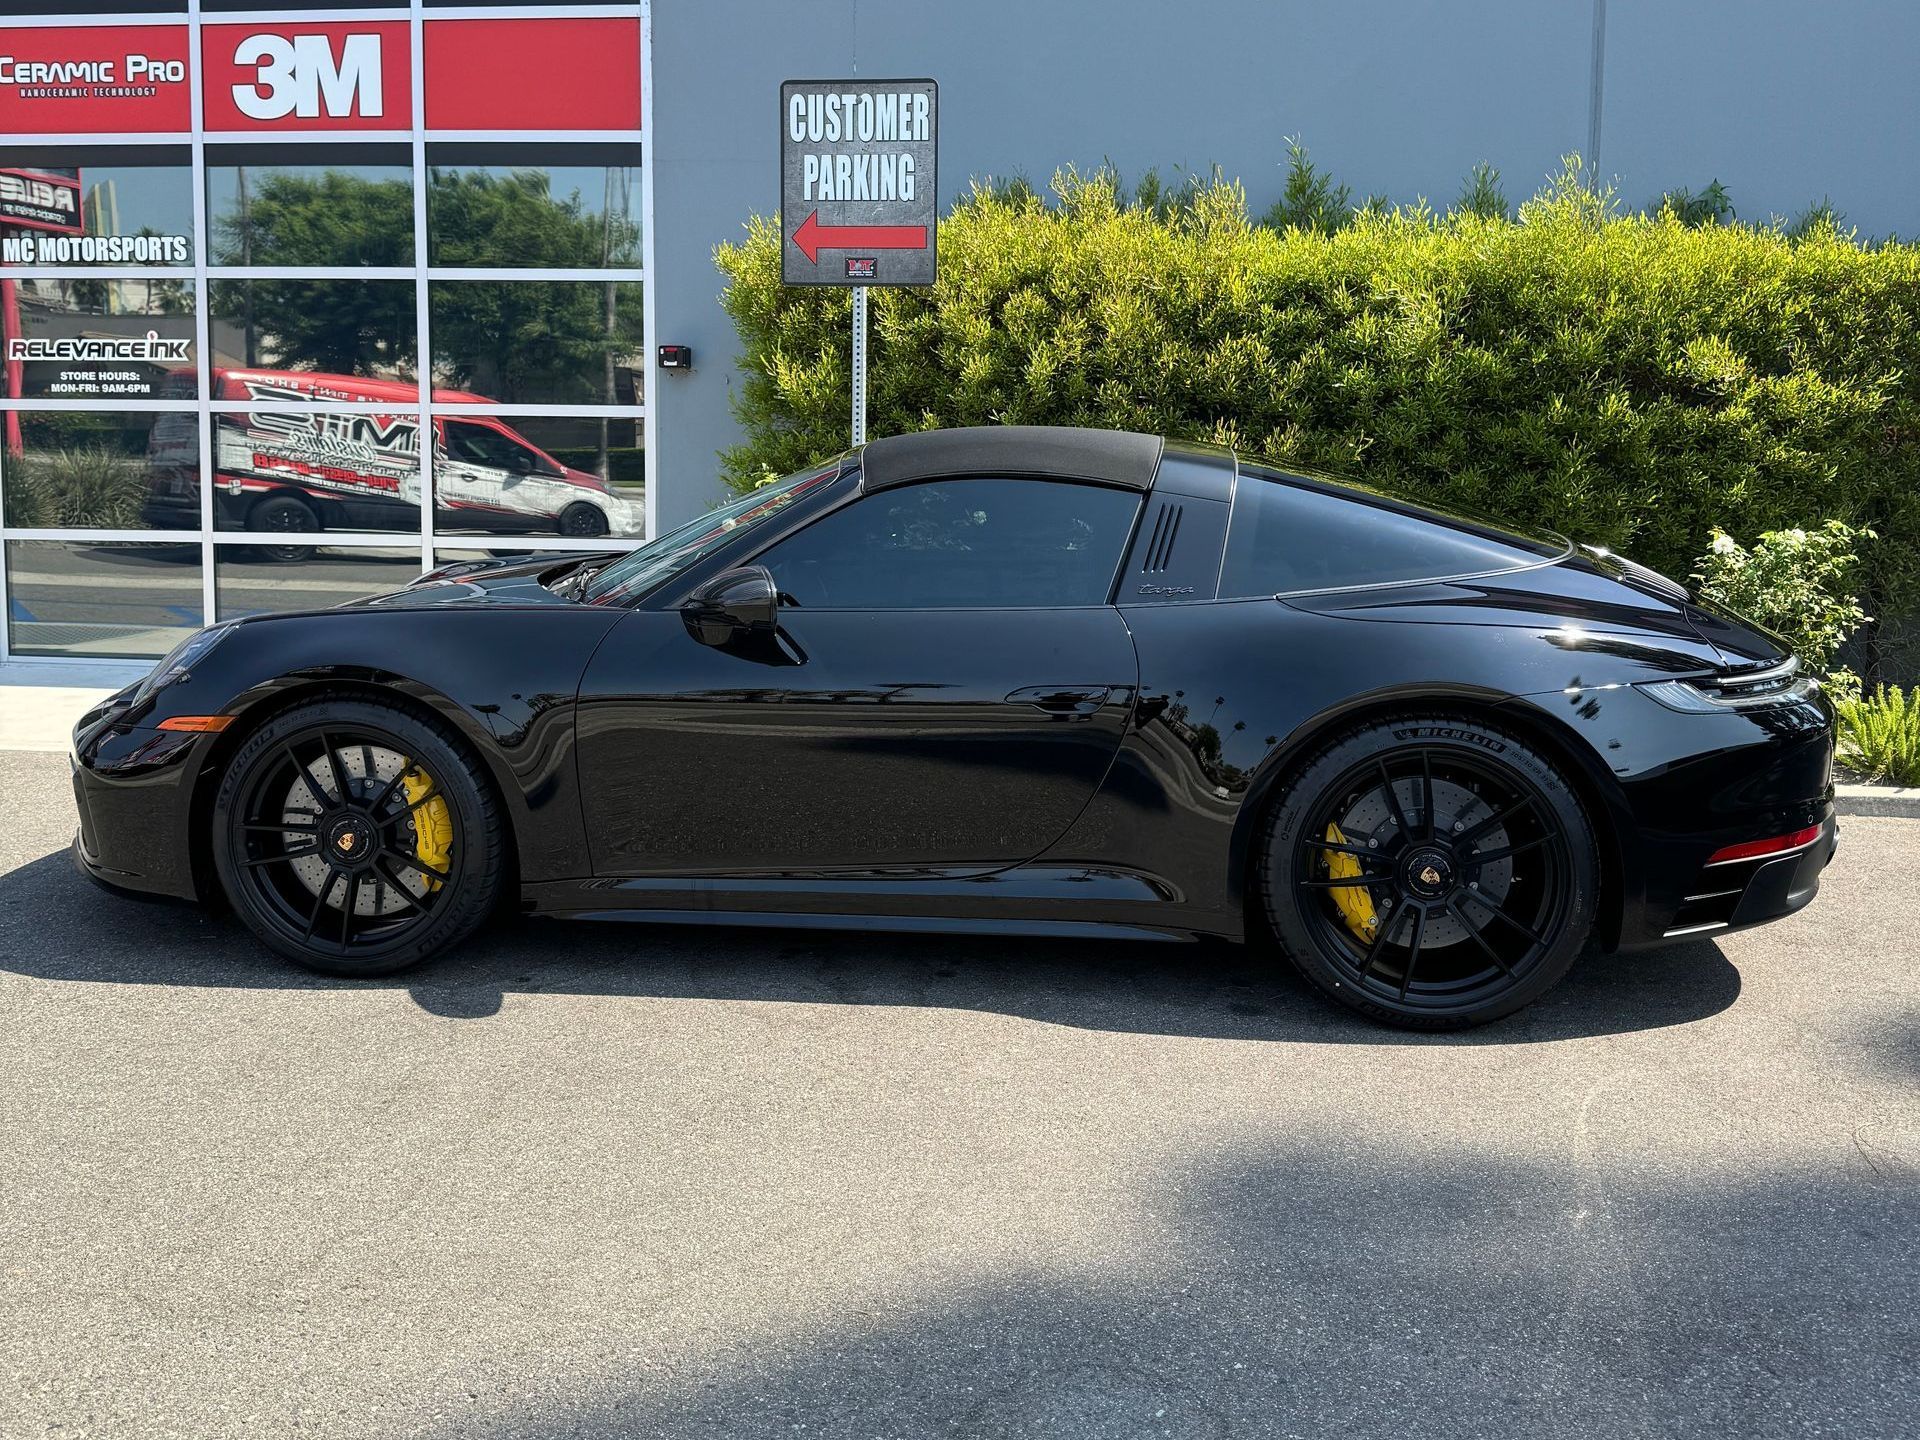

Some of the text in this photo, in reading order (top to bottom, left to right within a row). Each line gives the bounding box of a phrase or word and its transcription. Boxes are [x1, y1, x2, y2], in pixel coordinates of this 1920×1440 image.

[0, 55, 185, 84] CERAMIC PRO
[232, 34, 383, 120] 3M
[20, 86, 156, 98] NANOCERAMIC TECHNOLOGY
[789, 93, 930, 143] CUSTOMER
[803, 153, 915, 202] PARKING
[3, 236, 187, 262] MC MOTORSPORTS
[11, 340, 146, 360] RELEVANCE
[51, 383, 150, 393] MON-FRI: 9AM-6PM
[60, 371, 140, 381] STORE HOURS:
[1417, 727, 1502, 750] MICHELIN
[418, 809, 430, 850] ORSCHE
